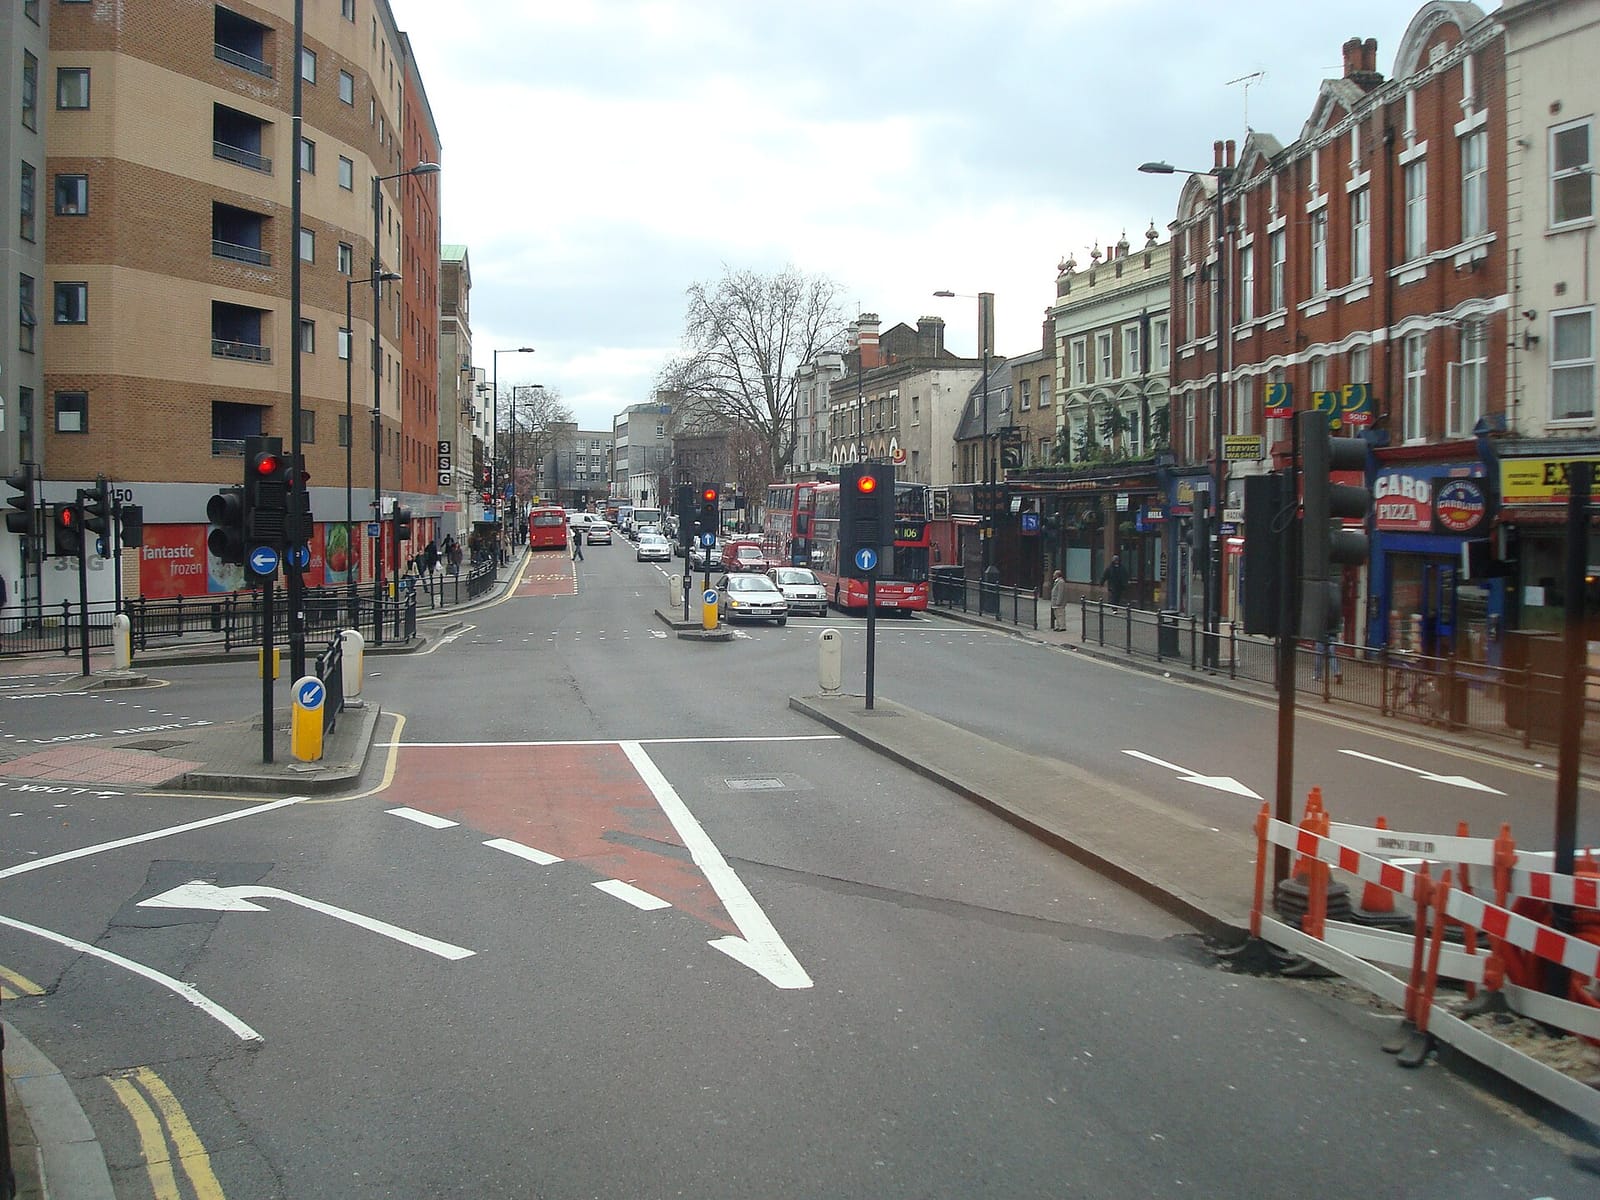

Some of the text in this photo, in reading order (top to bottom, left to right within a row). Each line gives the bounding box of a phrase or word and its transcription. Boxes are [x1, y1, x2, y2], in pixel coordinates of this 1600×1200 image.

[1349, 413, 1367, 421] SOLD
[1375, 474, 1431, 504] CARO
[1378, 504, 1417, 521] PIZZA
[903, 528, 917, 538] 106
[142, 544, 195, 560] fantastic
[170, 561, 202, 576] frozen
[32, 723, 183, 744] LOOK RIGHT
